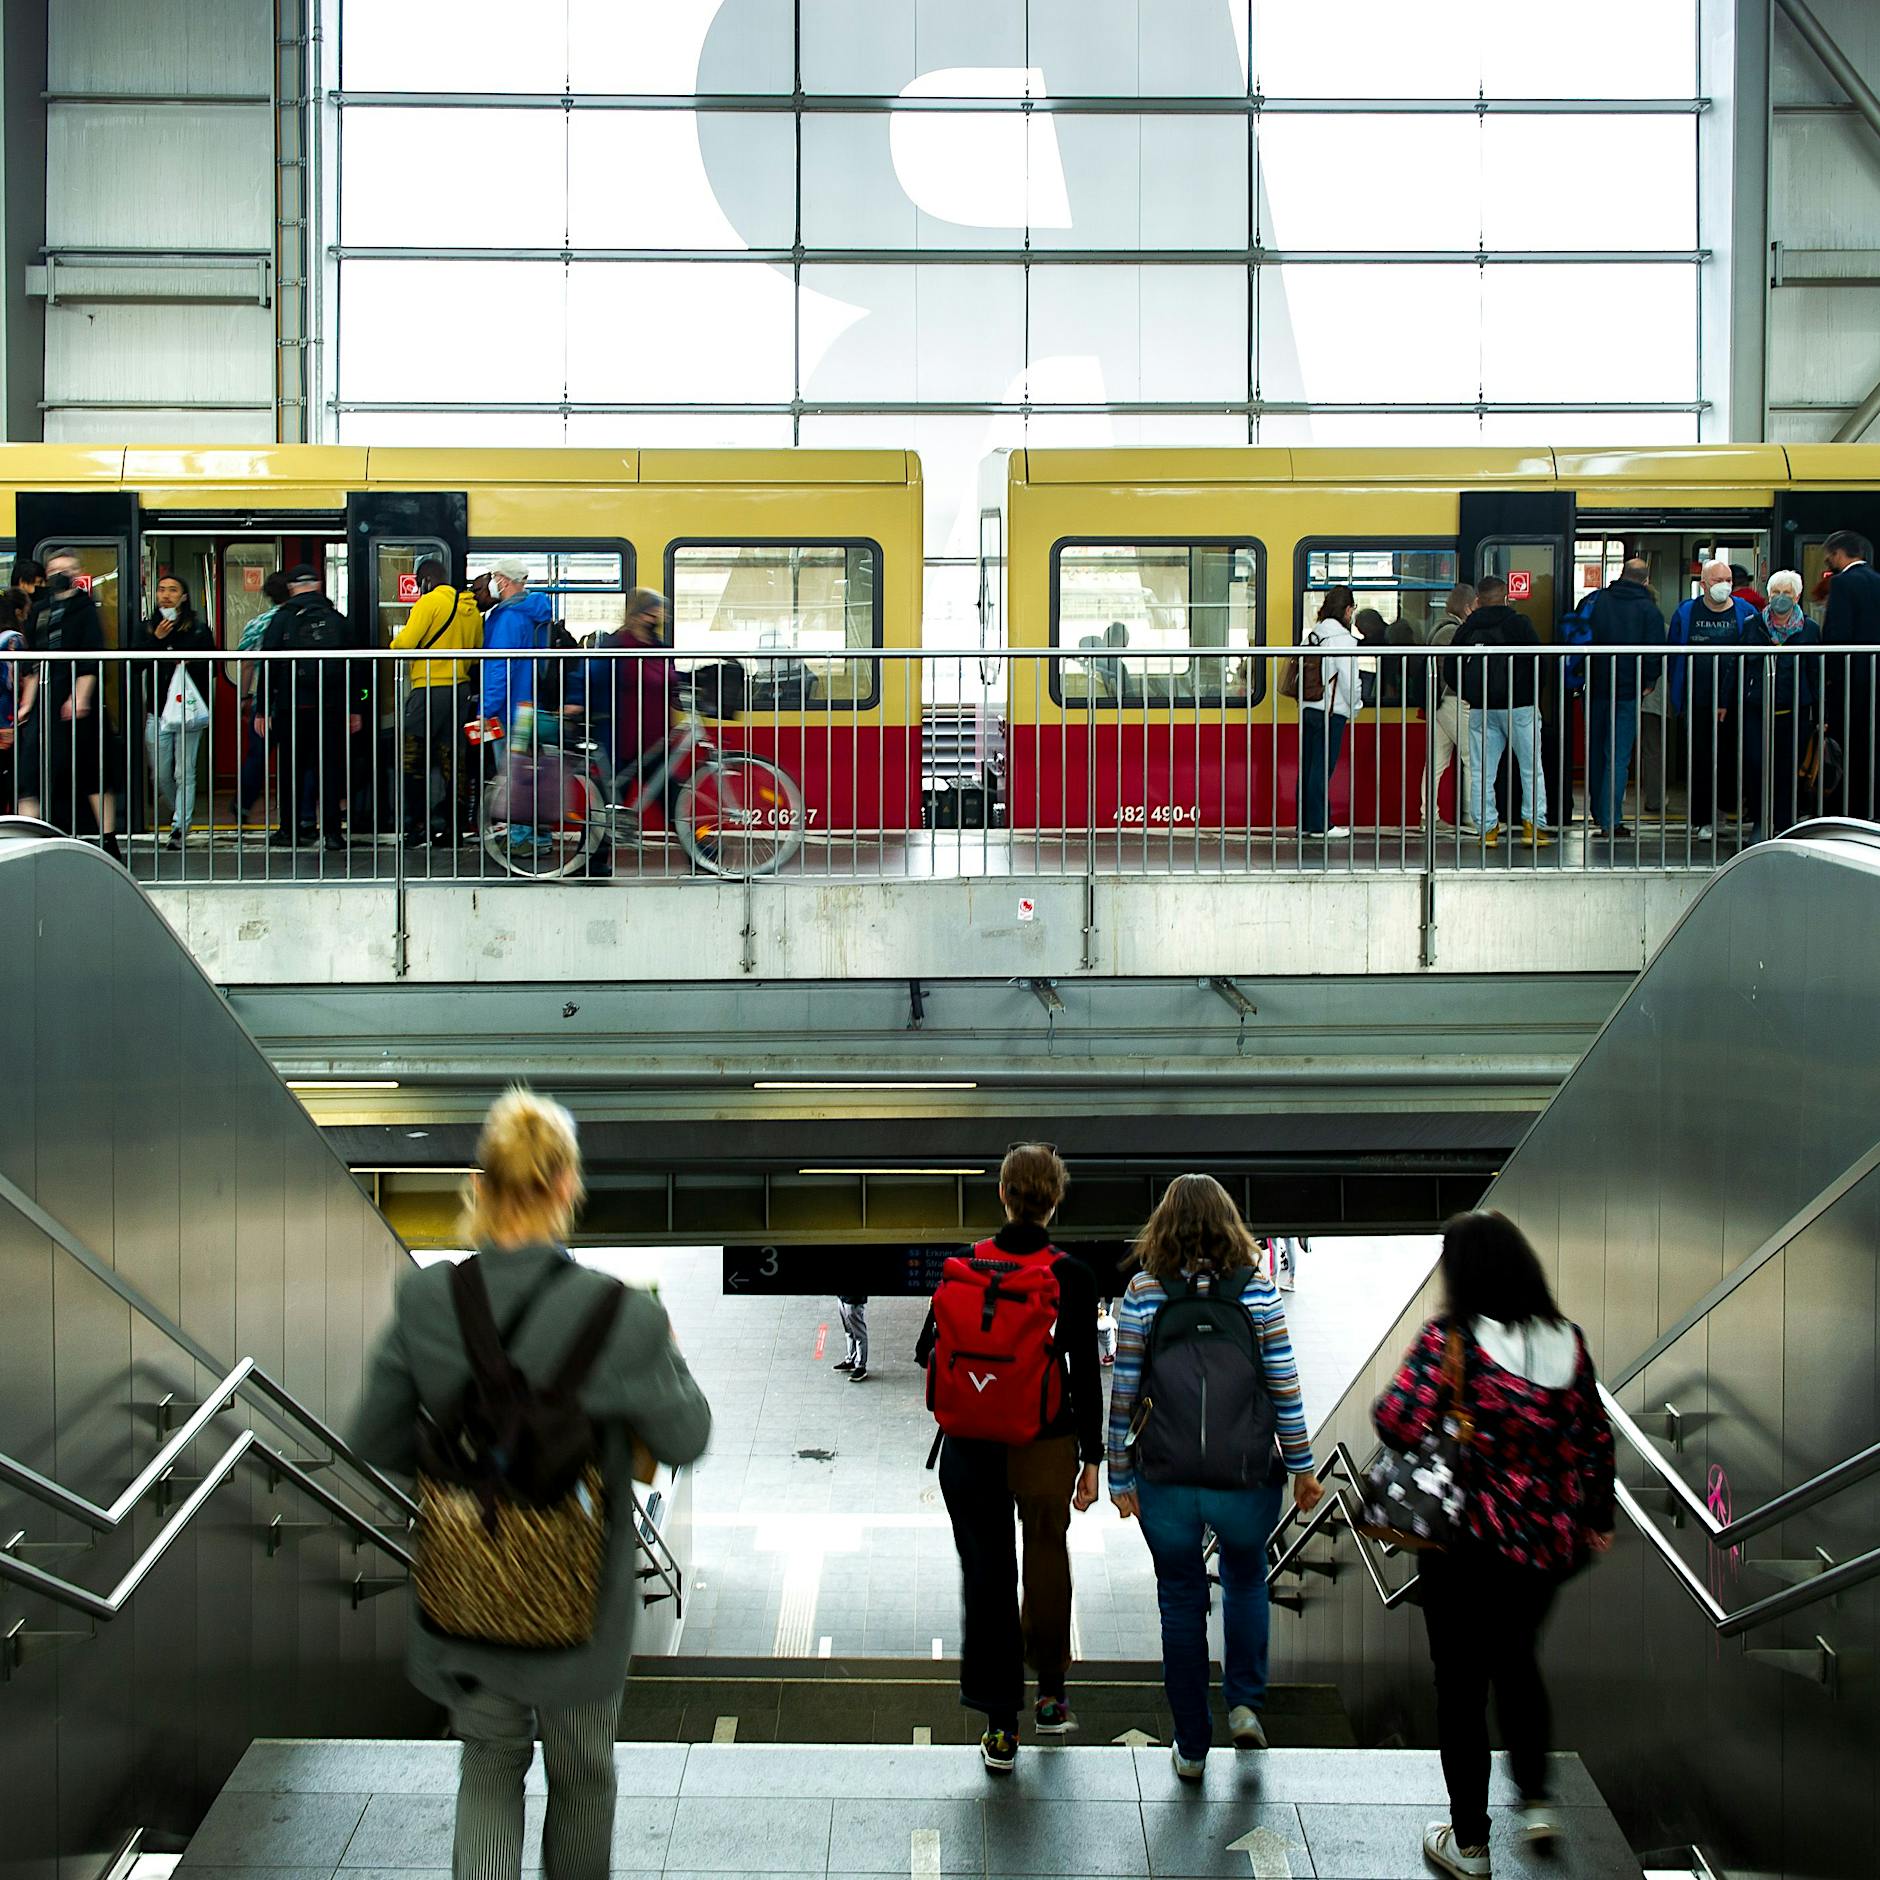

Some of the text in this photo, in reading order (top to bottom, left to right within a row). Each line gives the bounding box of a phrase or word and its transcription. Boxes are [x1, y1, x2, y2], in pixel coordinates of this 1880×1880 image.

[1113, 805, 1201, 822] 482 490-0
[925, 1248, 953, 1257] Erkner
[759, 1246, 779, 1277] 3
